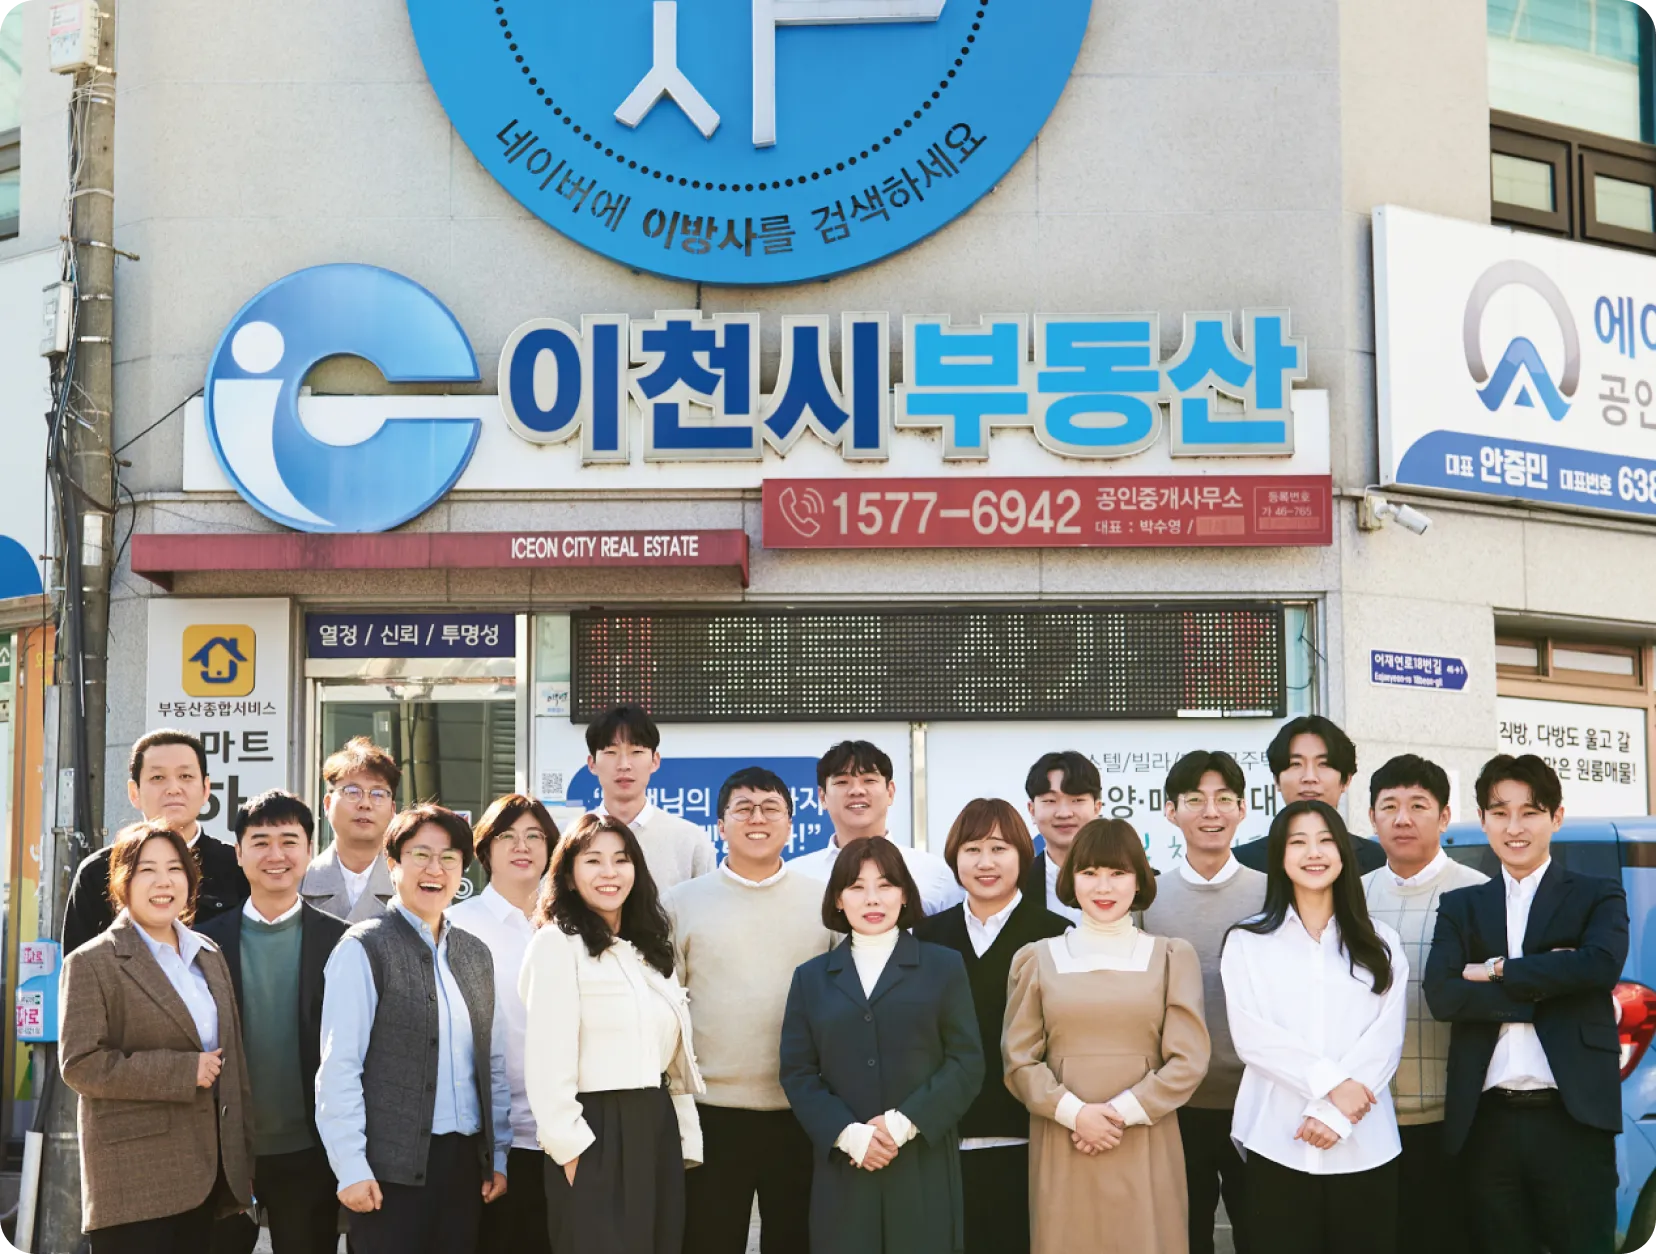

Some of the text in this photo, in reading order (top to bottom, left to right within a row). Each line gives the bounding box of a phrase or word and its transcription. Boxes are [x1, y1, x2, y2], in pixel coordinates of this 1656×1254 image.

[496, 118, 987, 257] 네이버에 이방사를 검색하세요
[1445, 453, 1475, 478] 대표
[1480, 446, 1549, 490] 안증민
[1559, 468, 1614, 497] 대표번호
[1095, 486, 1244, 511] 공인중개사무소
[832, 488, 1082, 535] 1577-6942
[1095, 520, 1123, 534] 대표
[1139, 519, 1182, 534] 박수영
[511, 535, 699, 559] ICEON CITY REAL ESTATE
[319, 624, 357, 646] 열정
[380, 624, 418, 646] 신뢰
[441, 624, 499, 646] 투명성
[1374, 652, 1442, 676] 어재연로18번길
[157, 701, 277, 718] 부동산종합서비스
[200, 730, 274, 764] 마트
[1499, 721, 1630, 753] 직방, 다방도 울고 갈
[1576, 758, 1636, 784] 원룸매물!
